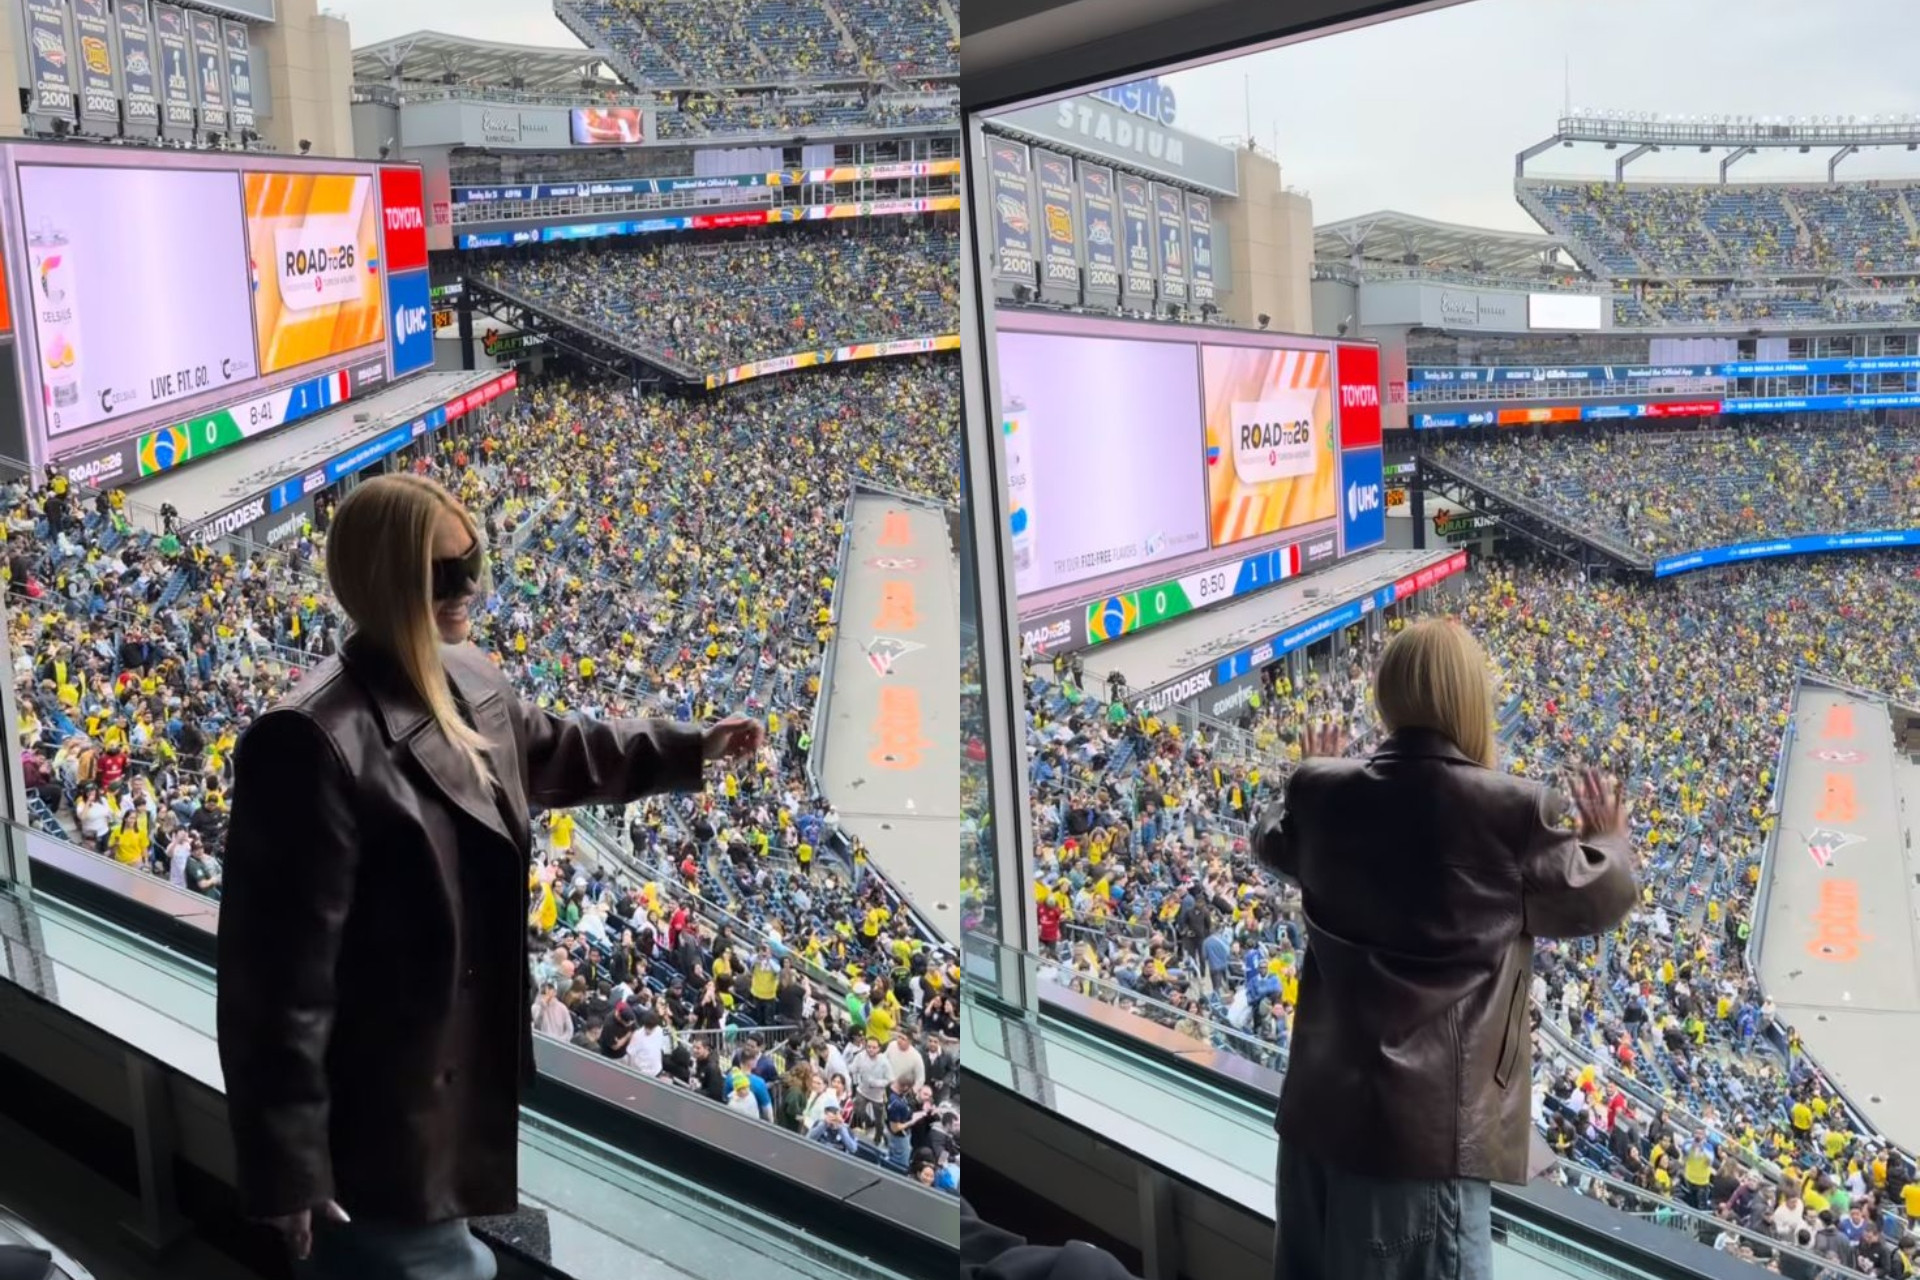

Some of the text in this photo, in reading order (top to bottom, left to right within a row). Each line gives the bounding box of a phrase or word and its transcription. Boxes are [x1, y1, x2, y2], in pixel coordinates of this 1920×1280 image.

[41, 92, 70, 107] 2001
[87, 98, 115, 112] 2003
[130, 102, 156, 116] 2004
[169, 107, 190, 120] 2014
[1057, 99, 1184, 166] STADIUM
[386, 207, 423, 231] TOYOTA
[286, 247, 327, 277] ROAD
[338, 244, 354, 269] 26
[1003, 257, 1032, 274] 2001
[1049, 264, 1076, 280] 2003
[1091, 271, 1116, 285] 2004
[1130, 278, 1150, 292] 2014
[405, 306, 427, 335] UHC
[151, 366, 209, 400] LIVE. FIT. GO.
[301, 389, 308, 408] 1
[1342, 385, 1378, 407] TOYOTA
[206, 421, 217, 444] 0
[1241, 423, 1282, 450] ROAD
[1294, 420, 1309, 444] 26
[69, 459, 99, 482] ROAD
[1008, 474, 1026, 488] SIUS
[1358, 484, 1379, 512] UHC
[203, 498, 265, 543] AUTODESK
[1081, 549, 1112, 567] FIZZ-FREE
[1251, 562, 1258, 582] 1
[1200, 573, 1225, 597] 8:50
[1155, 591, 1166, 614] 0
[1148, 669, 1212, 713] AUTODESK
